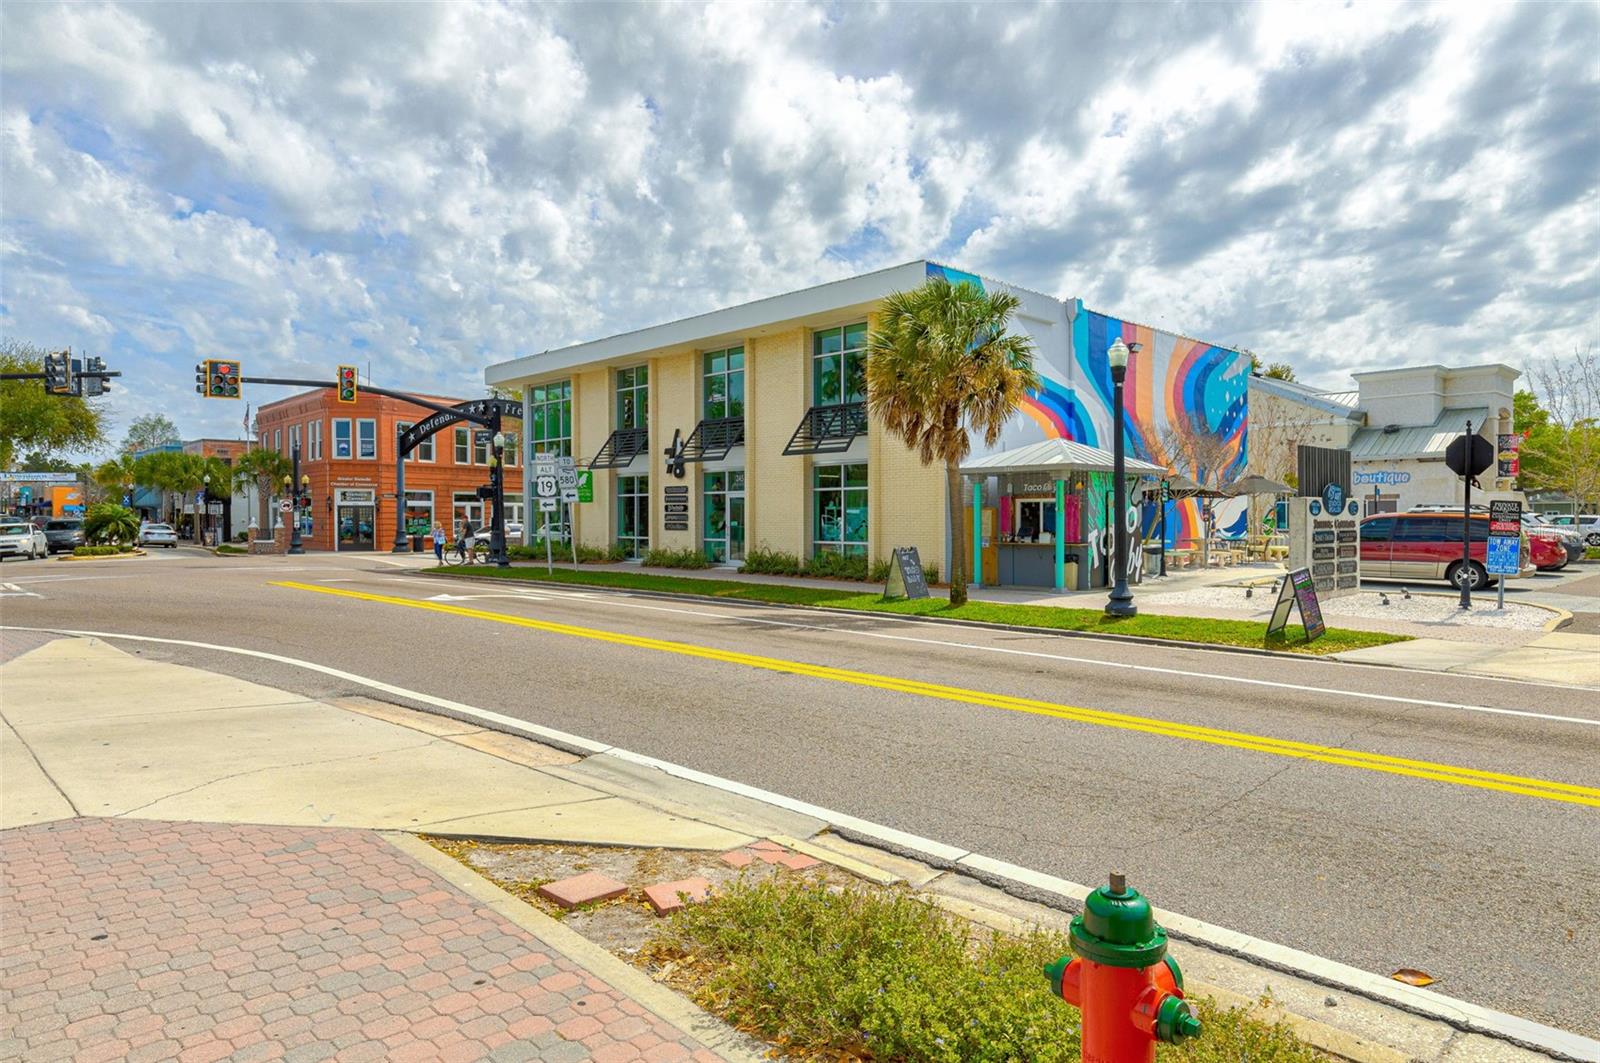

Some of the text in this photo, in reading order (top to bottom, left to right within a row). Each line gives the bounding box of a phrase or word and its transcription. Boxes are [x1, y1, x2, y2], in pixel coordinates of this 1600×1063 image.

[419, 409, 463, 434] Defend
[560, 476, 575, 484] 580
[1353, 471, 1410, 486] boutique
[541, 481, 553, 493] 19
[1023, 483, 1042, 492] Taco
